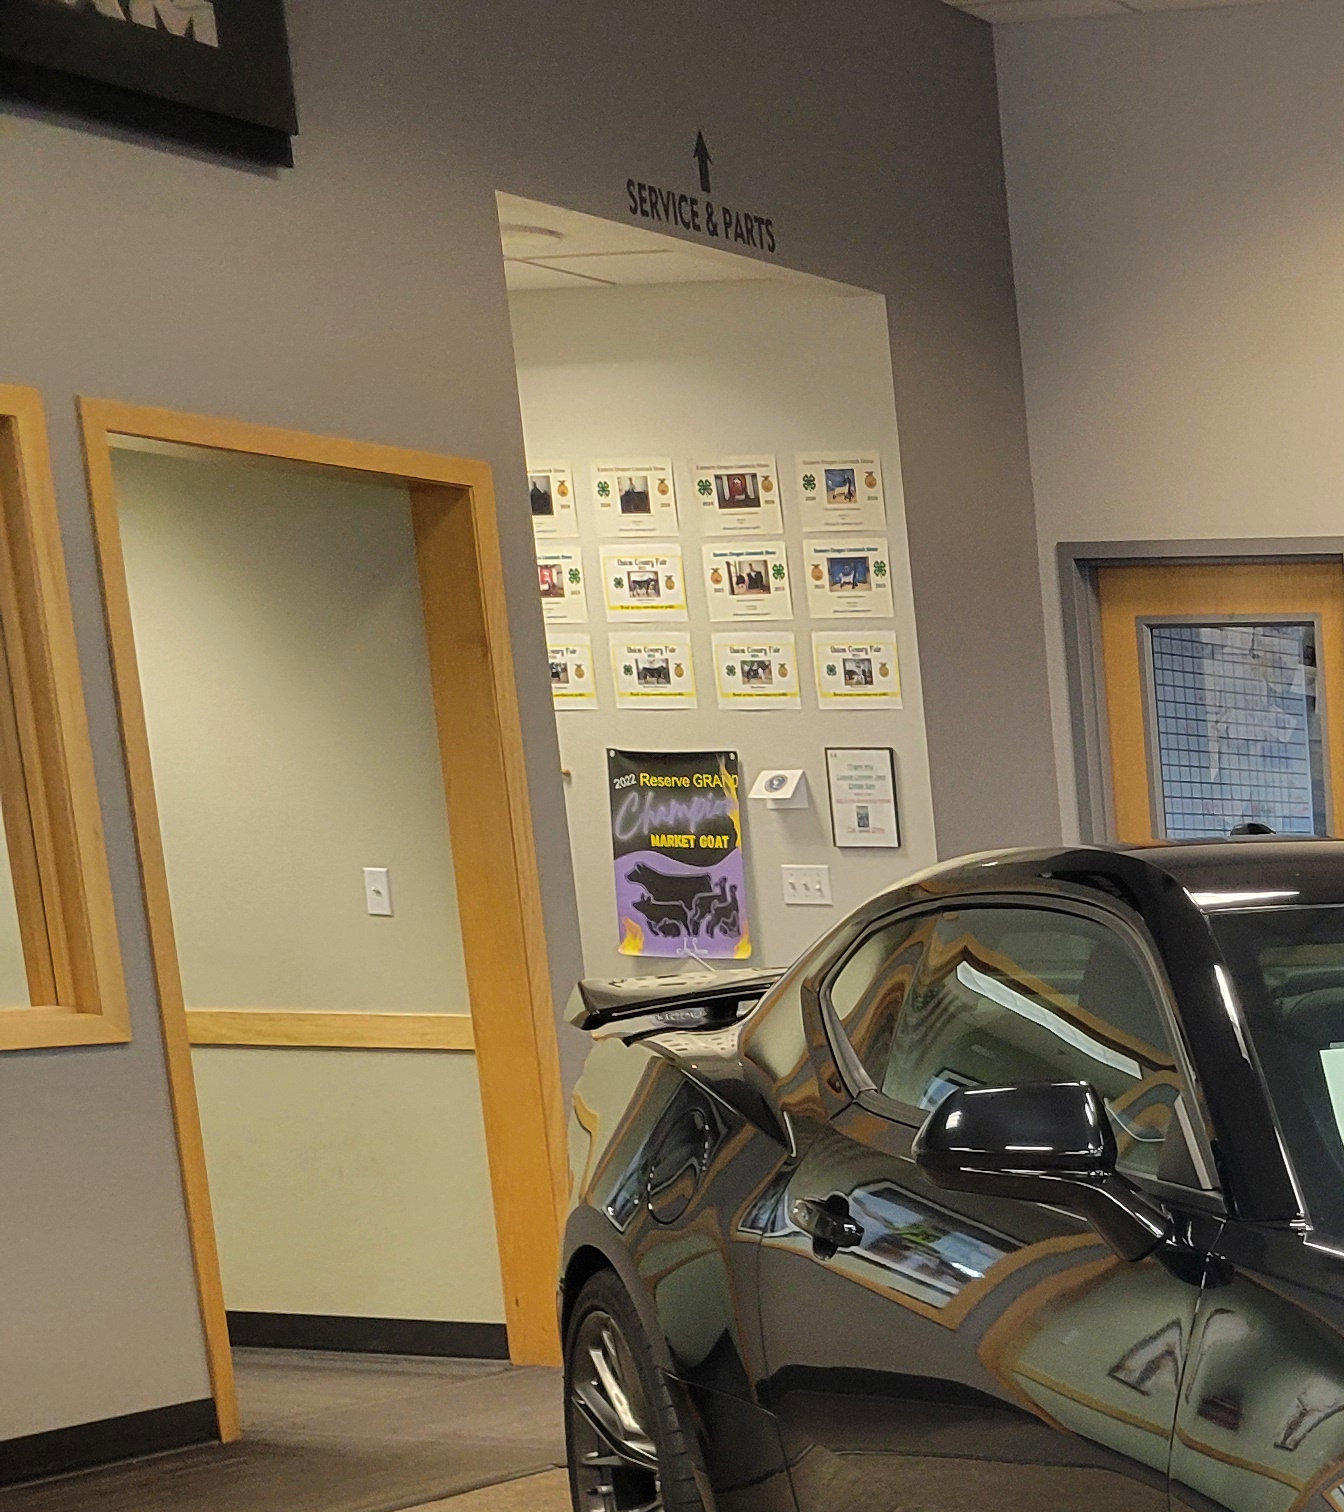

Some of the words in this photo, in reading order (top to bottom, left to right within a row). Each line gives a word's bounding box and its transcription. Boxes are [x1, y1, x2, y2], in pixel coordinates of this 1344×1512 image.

[626, 178, 702, 233] SERVICE
[706, 201, 719, 237] &
[722, 206, 776, 253] PARTS
[613, 774, 637, 789] 2022
[639, 772, 690, 788] Reserve
[650, 833, 696, 849] MARKET
[700, 834, 730, 849] GOAT
